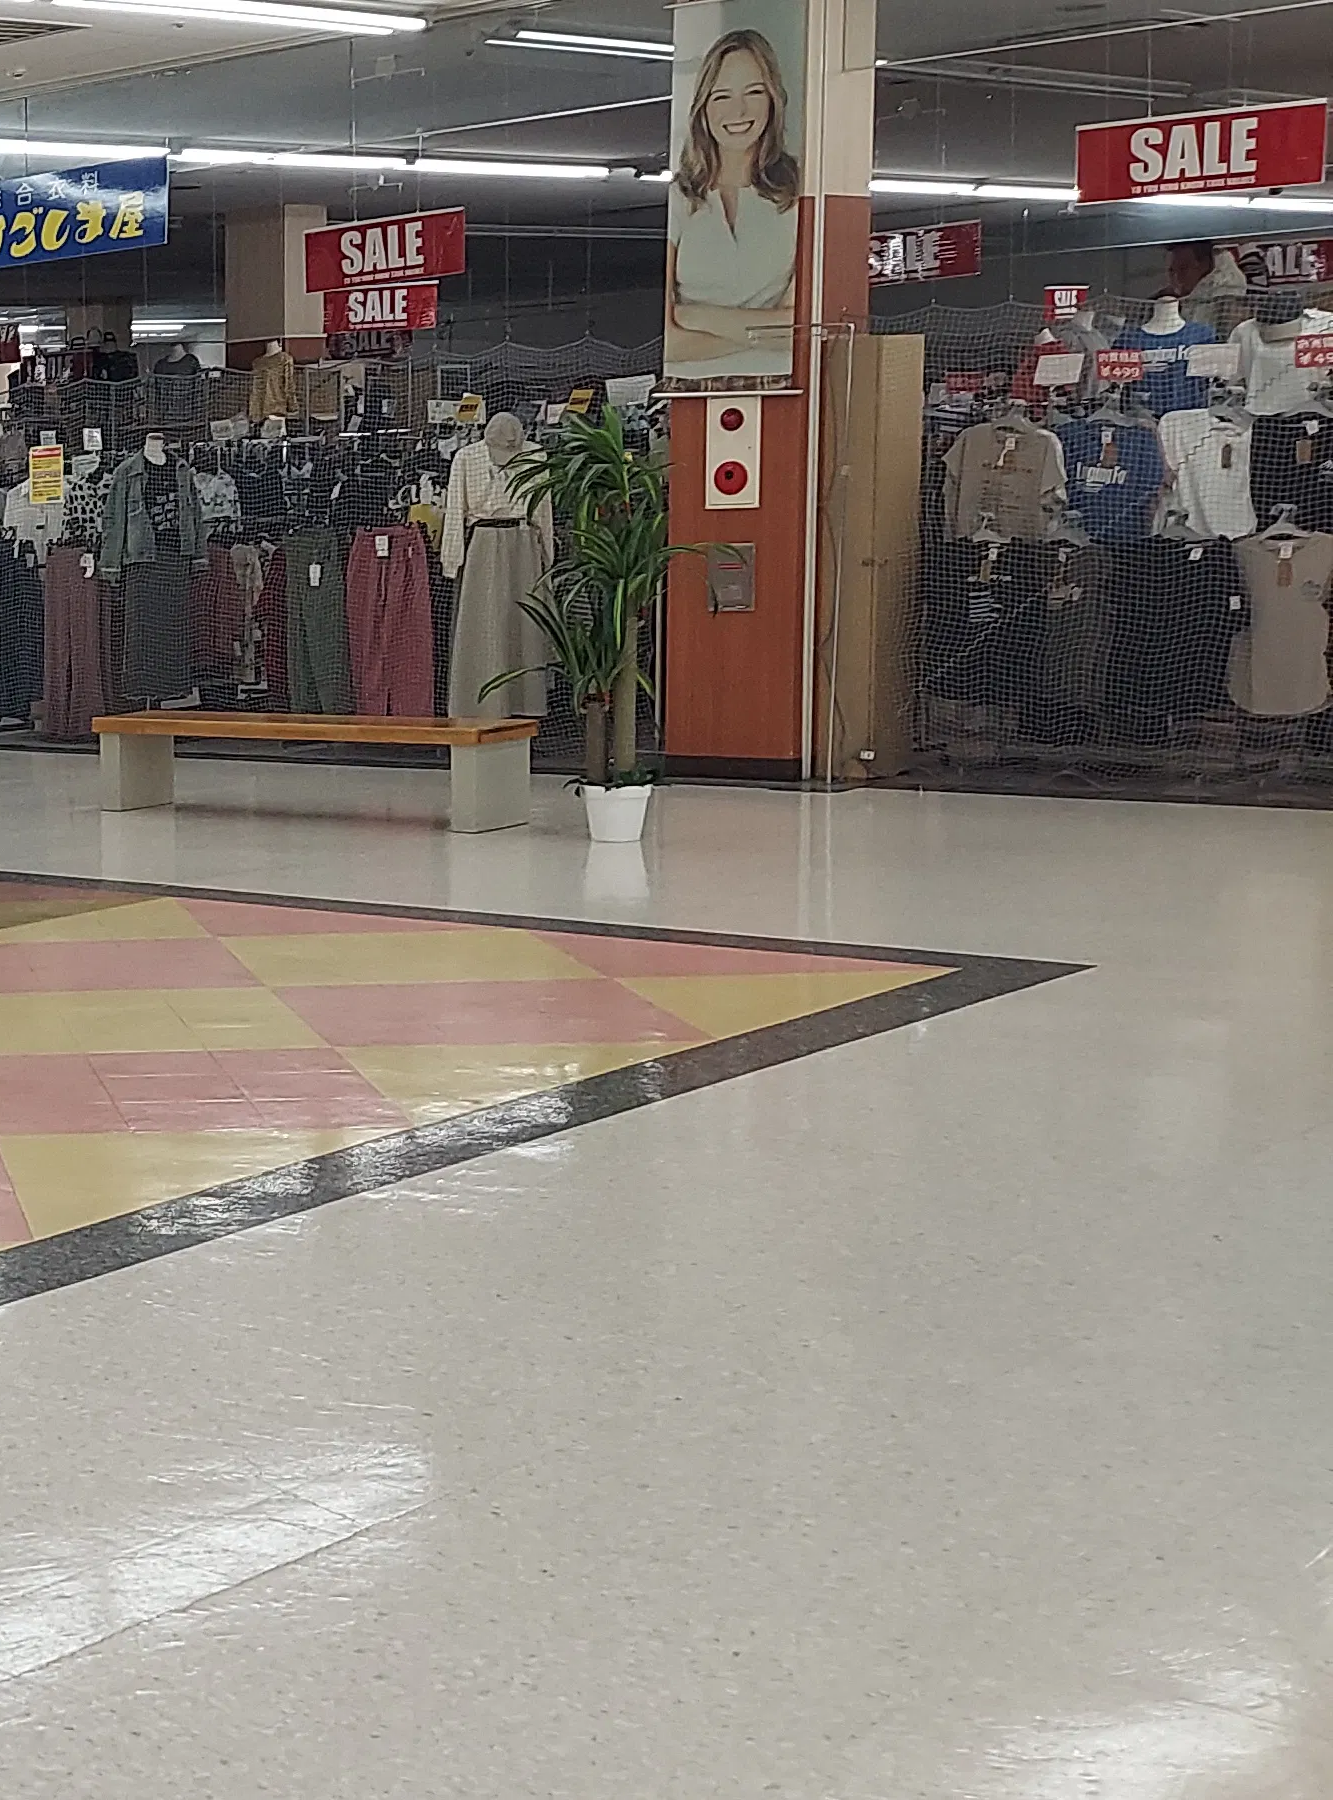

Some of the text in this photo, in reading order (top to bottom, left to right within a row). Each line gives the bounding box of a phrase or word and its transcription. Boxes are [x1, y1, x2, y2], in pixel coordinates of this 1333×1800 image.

[1129, 116, 1258, 183] SALE
[341, 221, 425, 275] SALE
[1265, 243, 1318, 276] ALE
[348, 289, 408, 323] SALE
